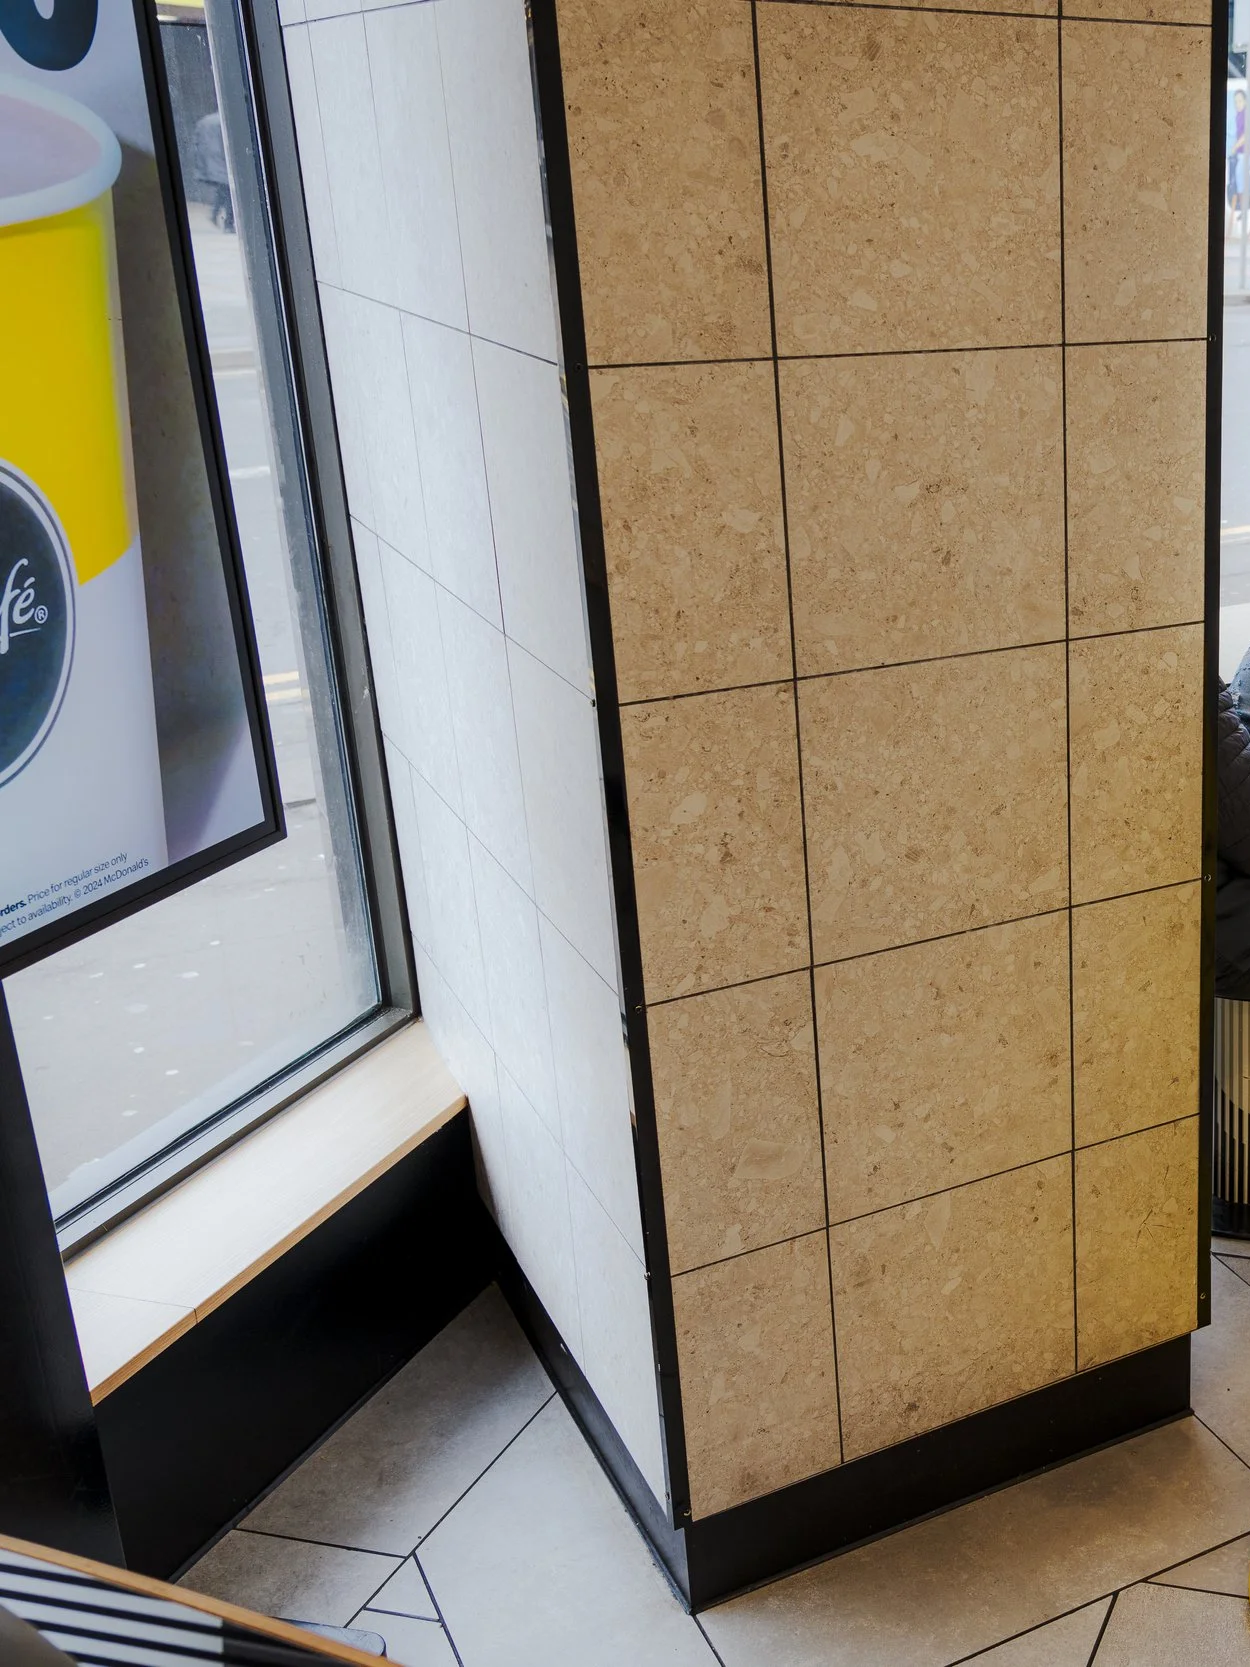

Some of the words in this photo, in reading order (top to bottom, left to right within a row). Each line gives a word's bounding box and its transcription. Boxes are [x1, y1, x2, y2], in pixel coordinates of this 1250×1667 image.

[16, 915, 27, 926] to
[82, 878, 103, 895] 2024
[103, 858, 149, 886] McDonald's
[27, 889, 50, 904] Price
[50, 882, 63, 894] for
[64, 868, 94, 887] regular
[94, 860, 110, 874] size
[110, 852, 128, 866] only
